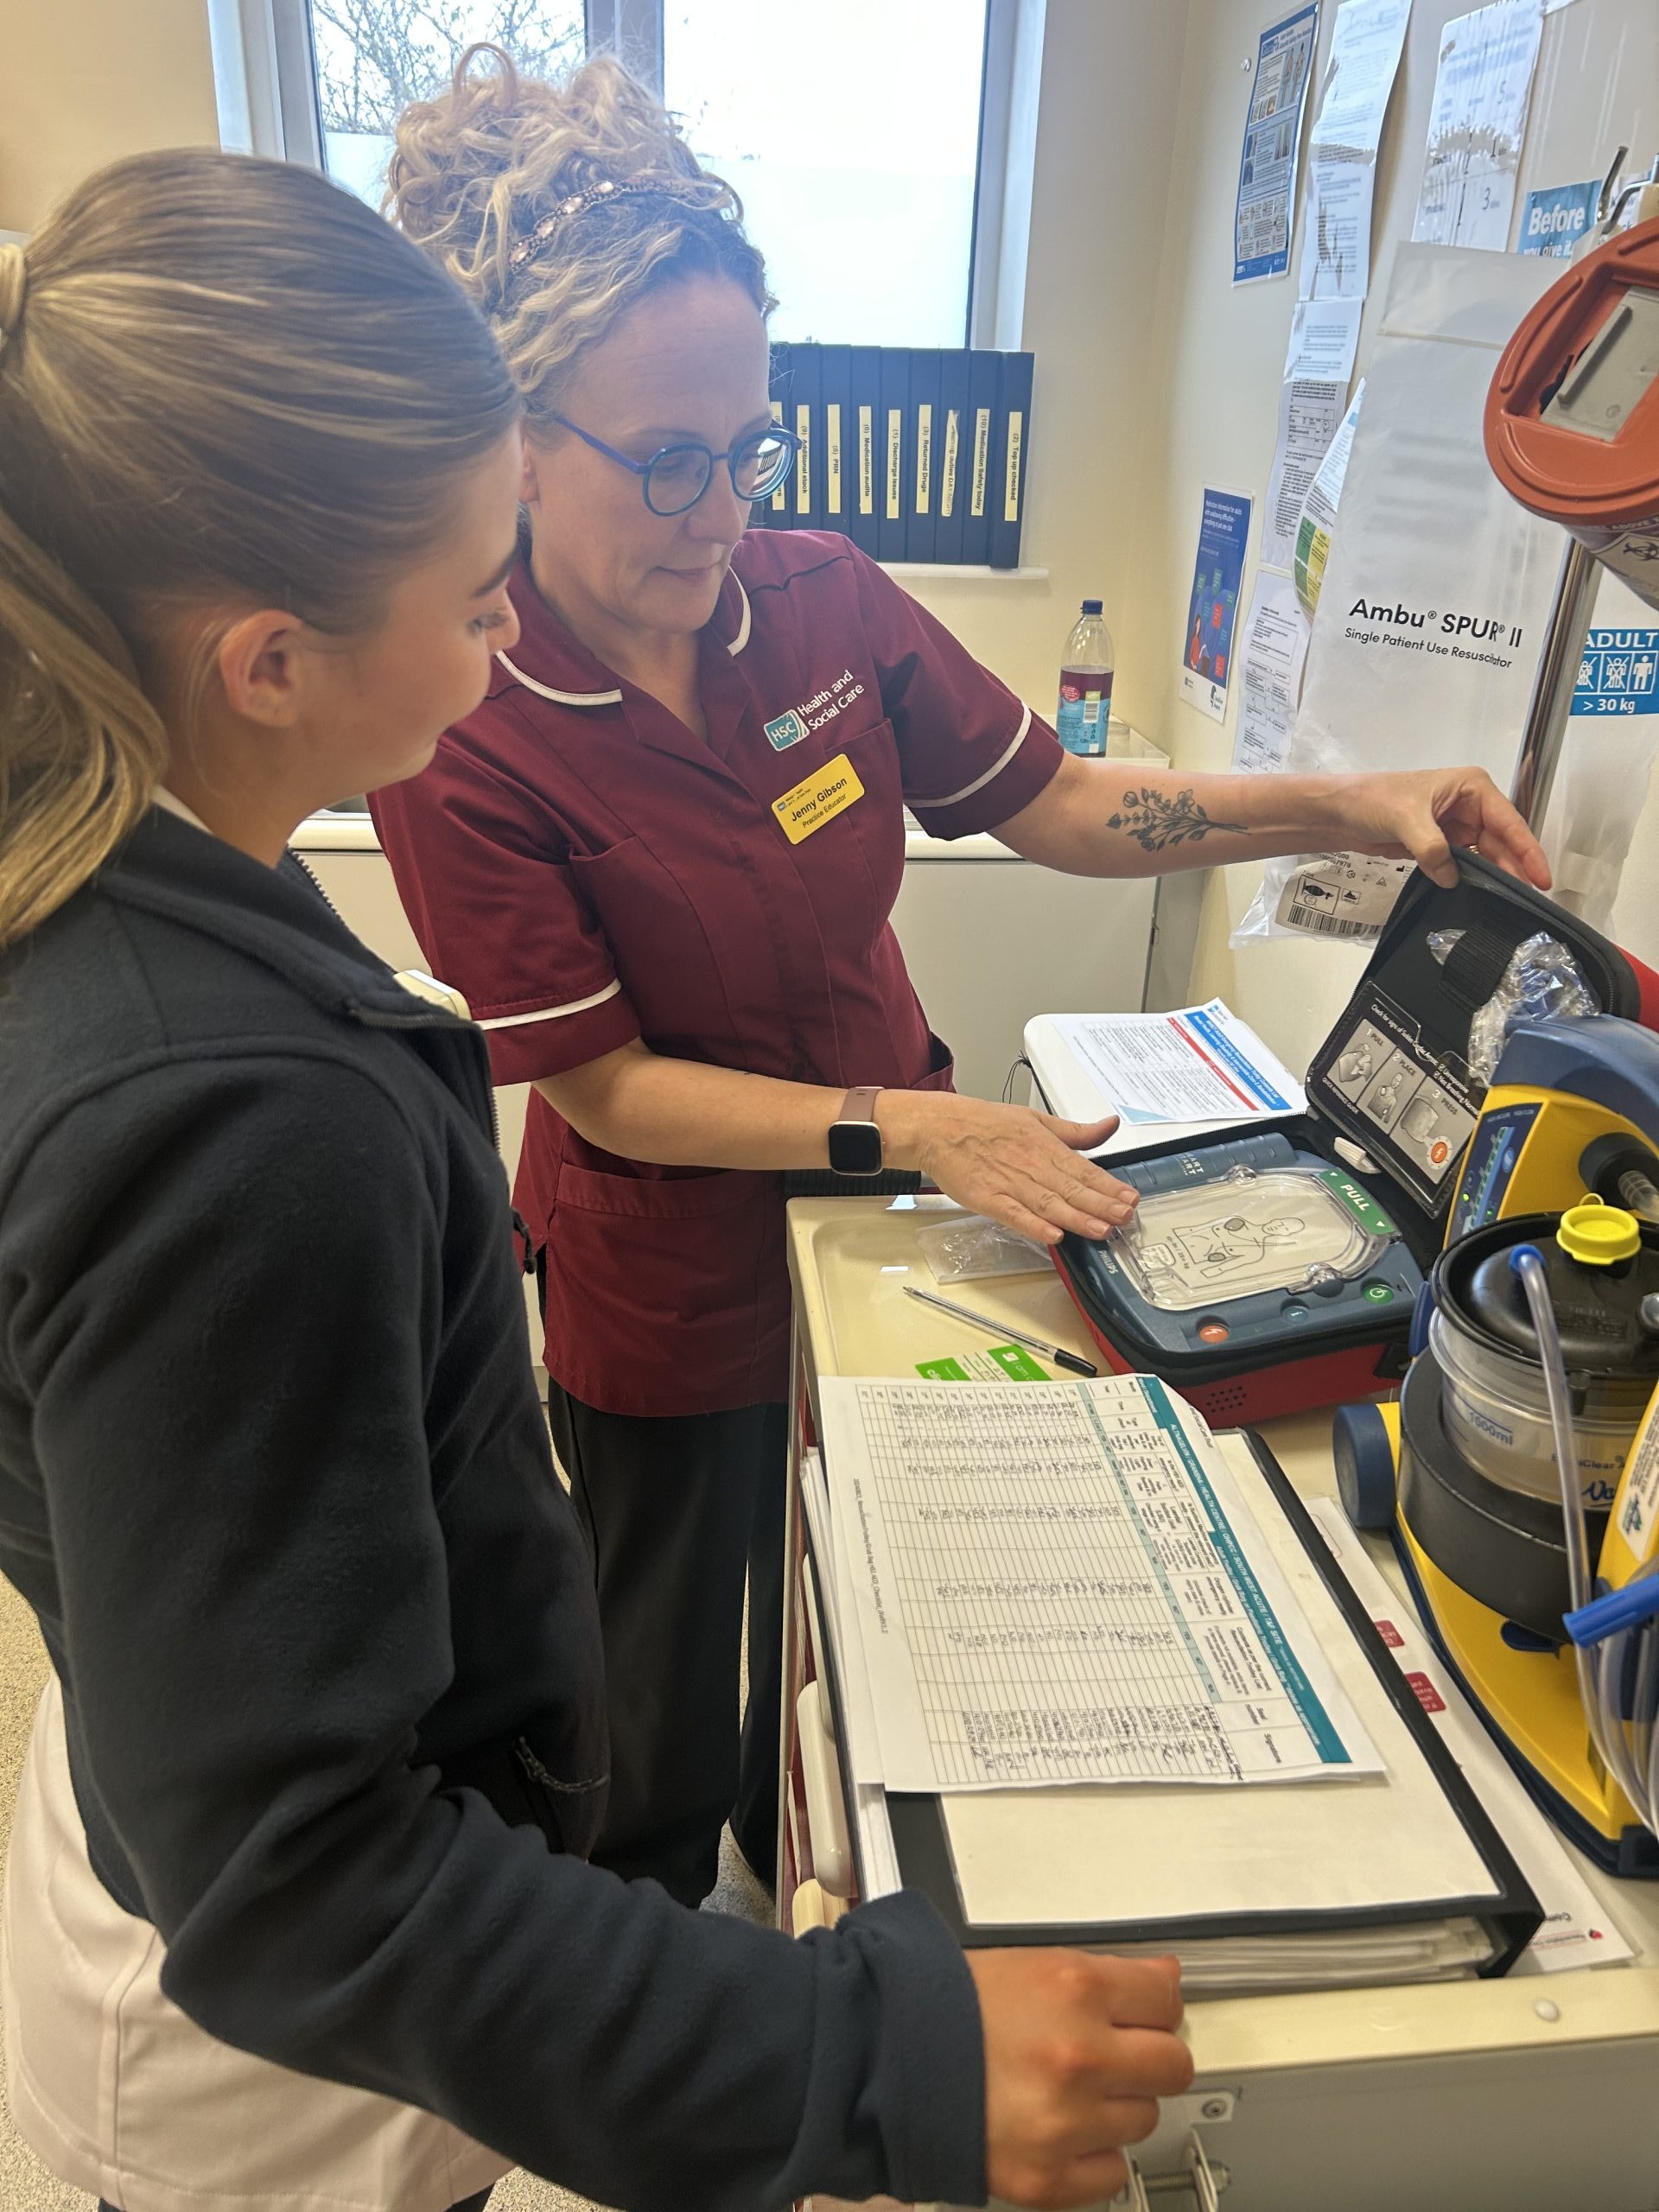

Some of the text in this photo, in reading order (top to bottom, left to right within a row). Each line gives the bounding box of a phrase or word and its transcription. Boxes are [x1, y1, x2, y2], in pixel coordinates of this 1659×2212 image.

[1482, 187, 1492, 211] 3
[1528, 204, 1586, 235] Before
[1523, 247, 1541, 257] you
[1541, 242, 1562, 257] give
[978, 430, 987, 467] Medication
[1011, 461, 1017, 471] up
[976, 470, 985, 490] Safety
[1344, 627, 1512, 669] Single Patient Use Resuscitator
[1509, 626, 1522, 648] II
[1585, 632, 1659, 648] ADULT
[798, 670, 855, 717] Health and
[1598, 698, 1618, 711] 30
[1619, 697, 1636, 714] kg
[808, 683, 865, 731] Social Care
[771, 721, 797, 743] HSC
[791, 798, 817, 822] Jenny
[817, 777, 848, 804] Gibson
[802, 810, 824, 828] Practice
[823, 792, 847, 815] Educator
[1370, 1003, 1427, 1055] Check for signs of Sudden Cardiac
[1371, 1033, 1383, 1047] PULL
[1392, 1052, 1417, 1077] 2 PLACE
[1437, 1075, 1465, 1103] Not Breathing
[1442, 1068, 1469, 1094] Unresponsive
[1432, 1090, 1459, 1116] 3 PRESS
[1339, 1184, 1368, 1211] PULL
[1098, 1249, 1119, 1274] PHILIPS
[1168, 1423, 1192, 1456] ALTNAGELVIN
[1468, 1411, 1513, 1446] 1000ml
[1185, 1459, 1205, 1484] GRANSHA
[1198, 1485, 1216, 1507] HEALTH
[1581, 1479, 1615, 1502] Va
[1209, 1507, 1226, 1529] CENTRE
[1231, 1555, 1249, 1575] SOUTH
[1211, 1576, 1235, 1613] Oxygen cylinder
[1242, 1575, 1257, 1592] WEST
[1204, 1576, 1228, 1616] emergency ready
[1249, 1592, 1268, 1613] ACUTE
[1235, 1626, 1251, 1648] Contents
[1268, 1629, 1283, 1643] SITE
[1229, 1629, 1262, 1689] Resuscitation Trolley List
[1247, 1653, 1258, 1663] per
[1253, 1662, 1262, 1672] the
[1257, 1672, 1272, 1691] current
[1244, 1703, 1261, 1725] number
[1255, 1707, 1268, 1720] Seal
[1261, 1732, 1283, 1764] Signature
